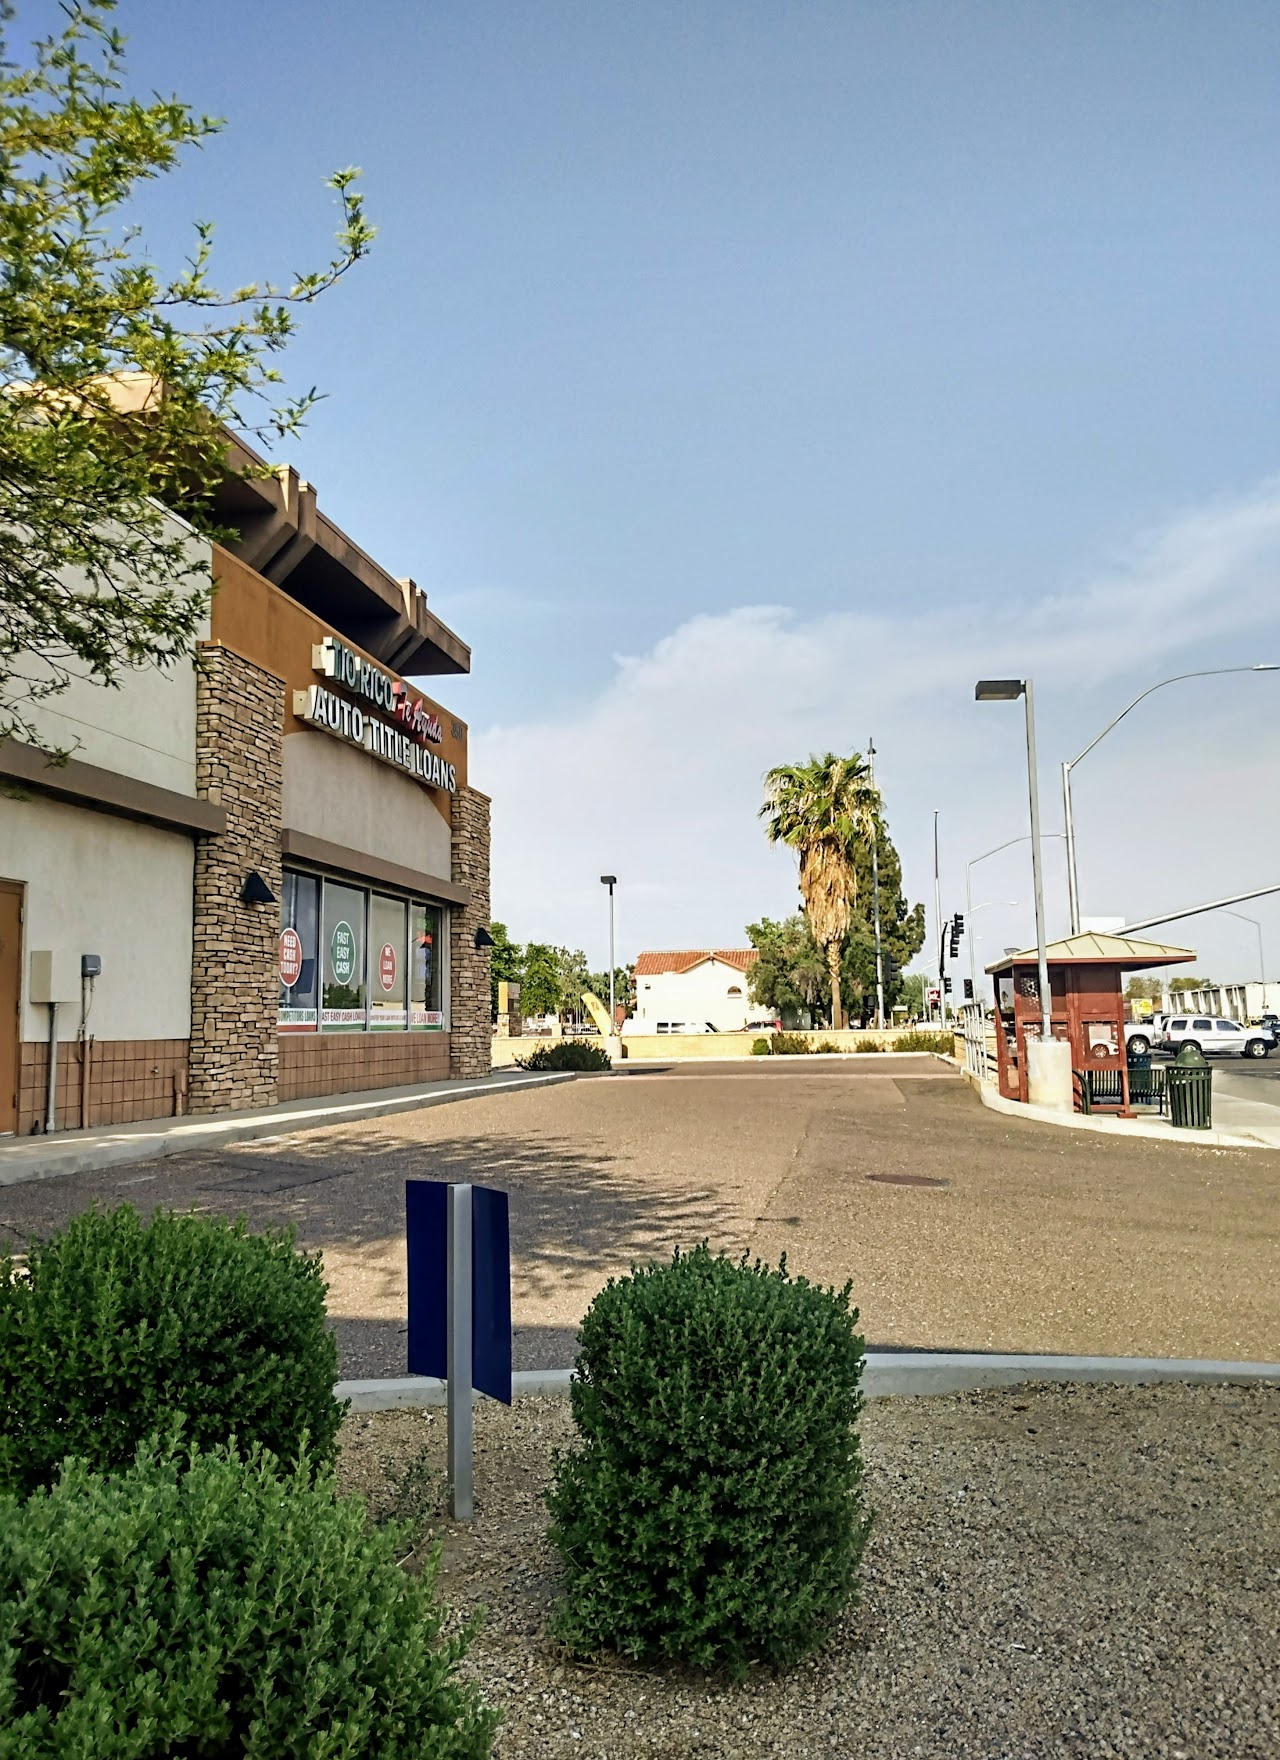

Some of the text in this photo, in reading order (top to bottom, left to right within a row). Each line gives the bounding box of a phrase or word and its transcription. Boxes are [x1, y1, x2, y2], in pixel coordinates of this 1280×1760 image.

[360, 658, 393, 711] RICO
[313, 686, 457, 794] AUTO TITLE LOANS
[284, 935, 297, 948] NEED
[337, 932, 350, 944] FAST
[284, 948, 296, 961] CASH
[336, 947, 350, 960] EASY
[384, 946, 392, 957] WE
[280, 961, 299, 975] TODAY?
[336, 961, 350, 974] CASH
[382, 960, 393, 971] LOAN
[382, 974, 393, 985] MORE
[322, 1011, 330, 1022] AST
[330, 1011, 341, 1022] EASY
[341, 1011, 353, 1022] CASH
